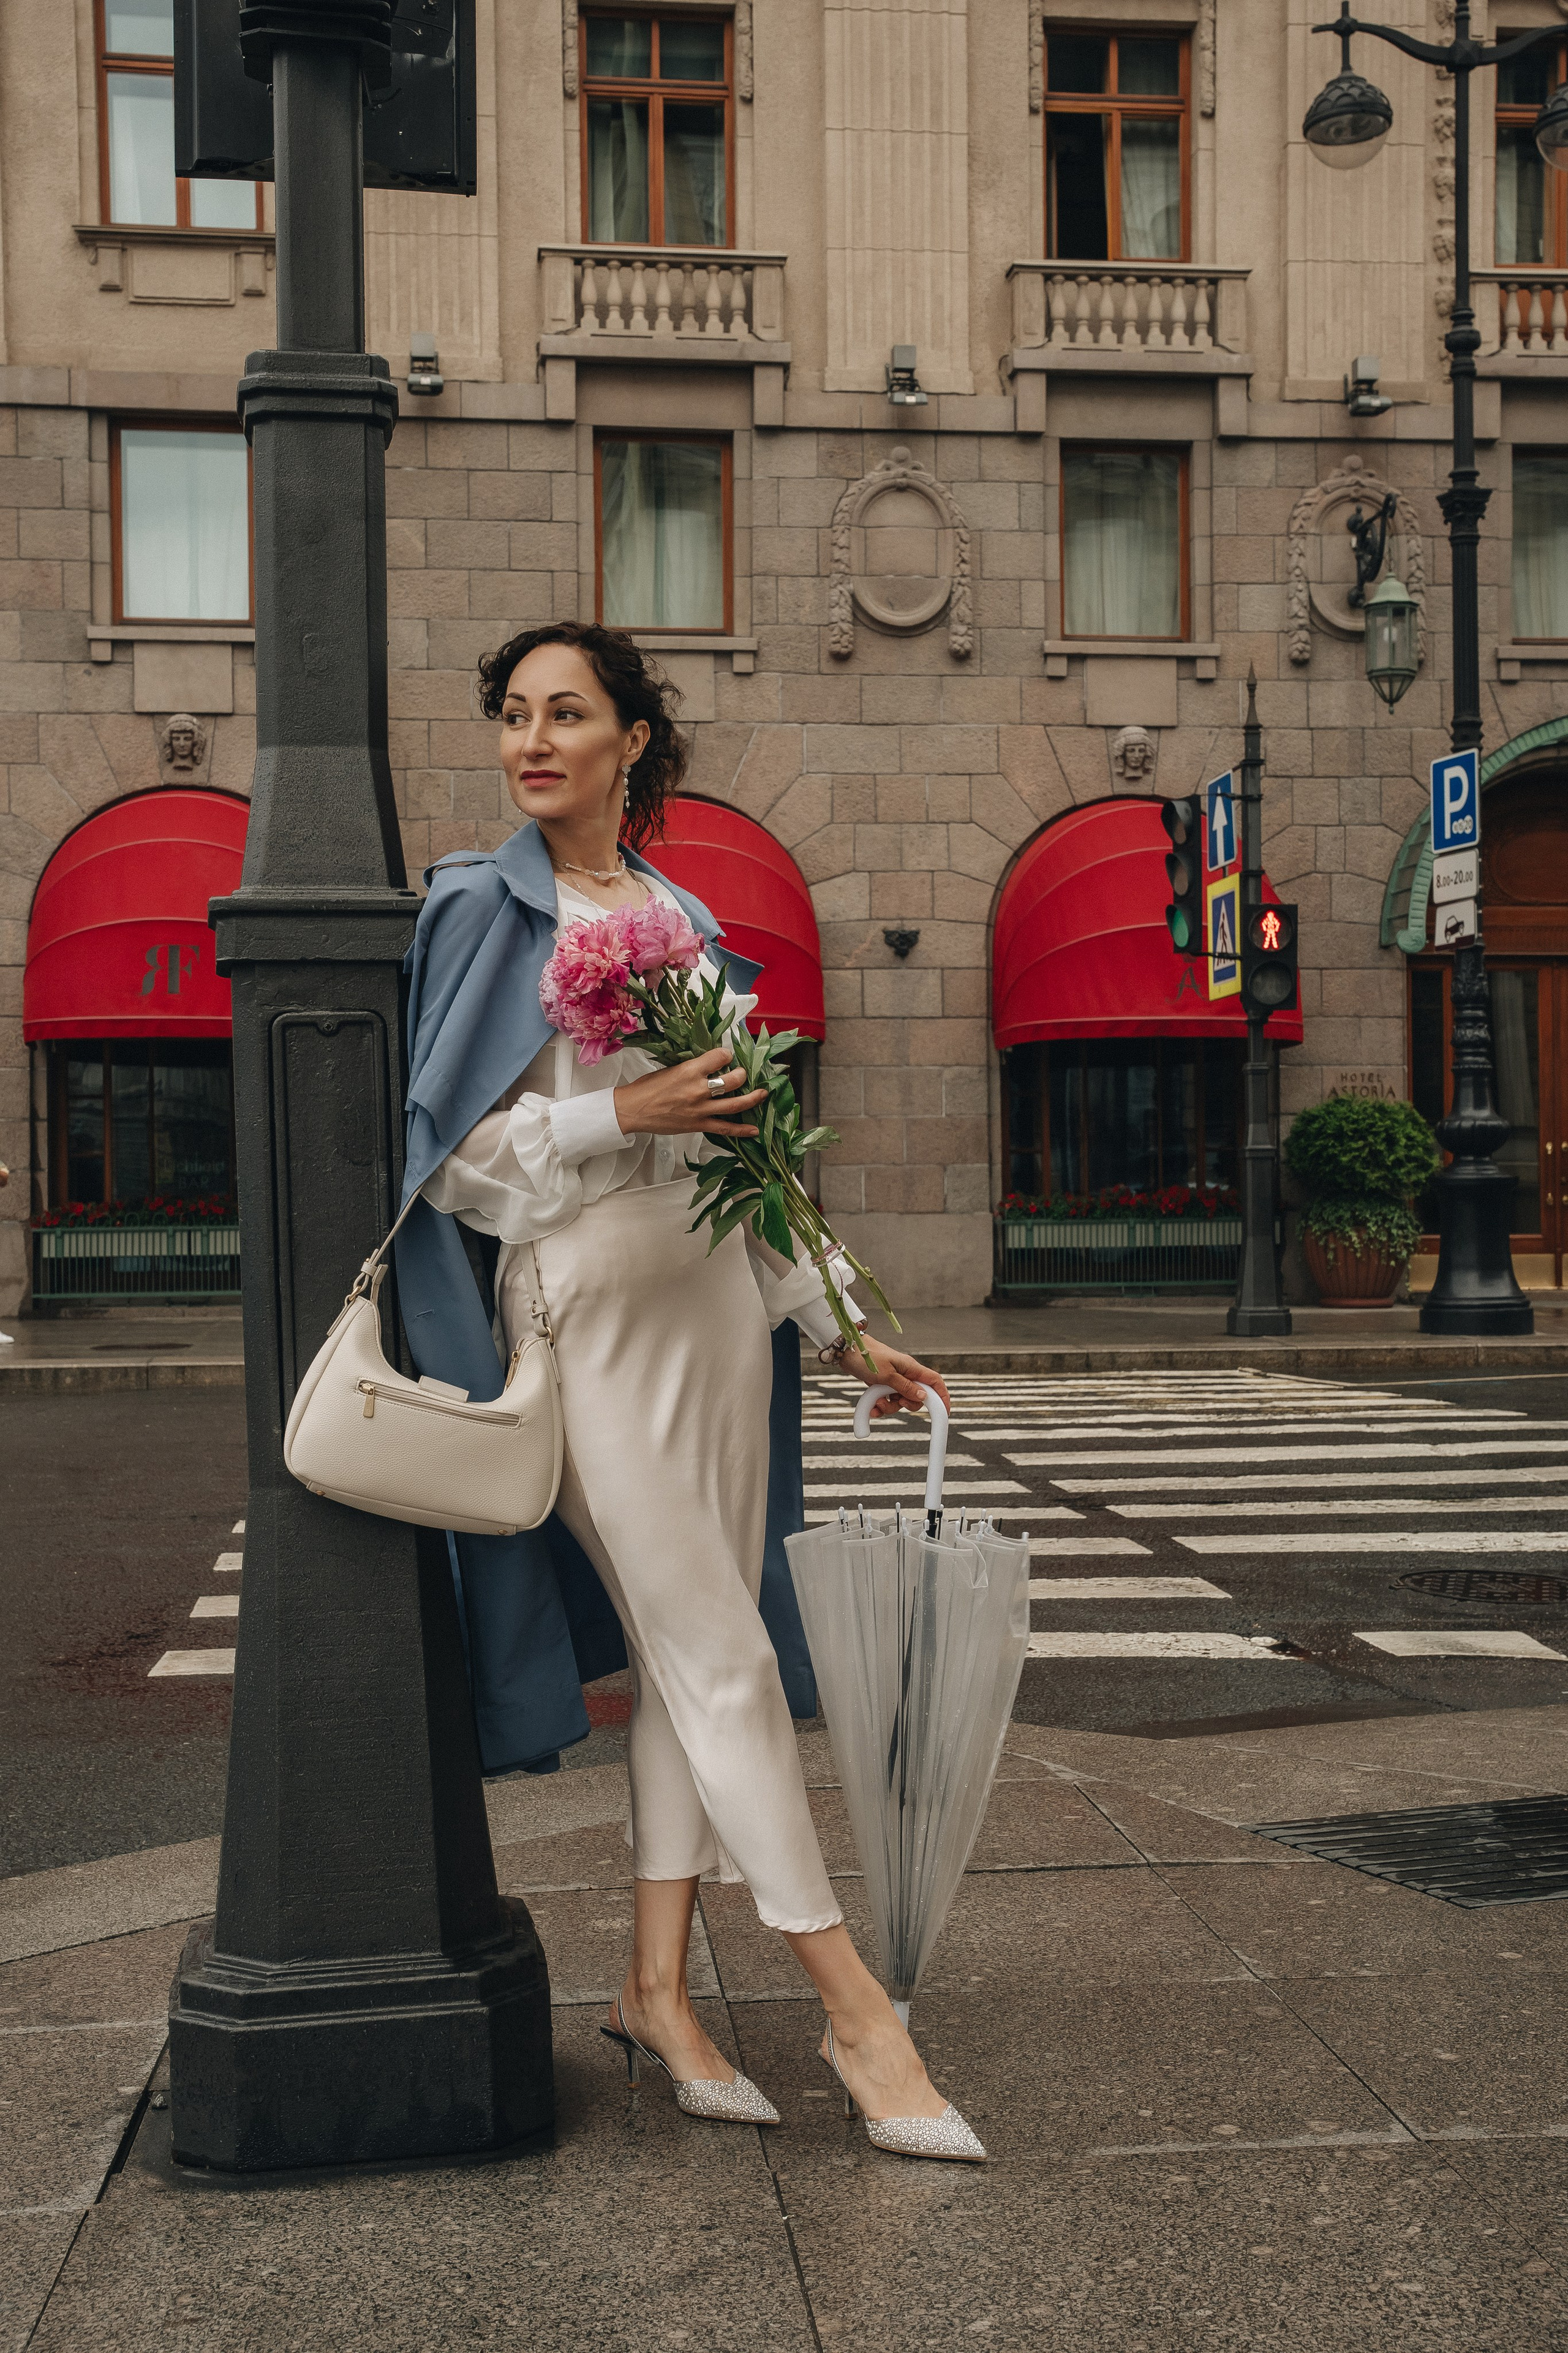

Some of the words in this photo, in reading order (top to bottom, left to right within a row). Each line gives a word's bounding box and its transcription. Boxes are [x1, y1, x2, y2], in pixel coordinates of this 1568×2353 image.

[1444, 765, 1469, 840] P
[1340, 1072, 1383, 1083] HOTEL
[1327, 1082, 1396, 1098] ASTORIA
